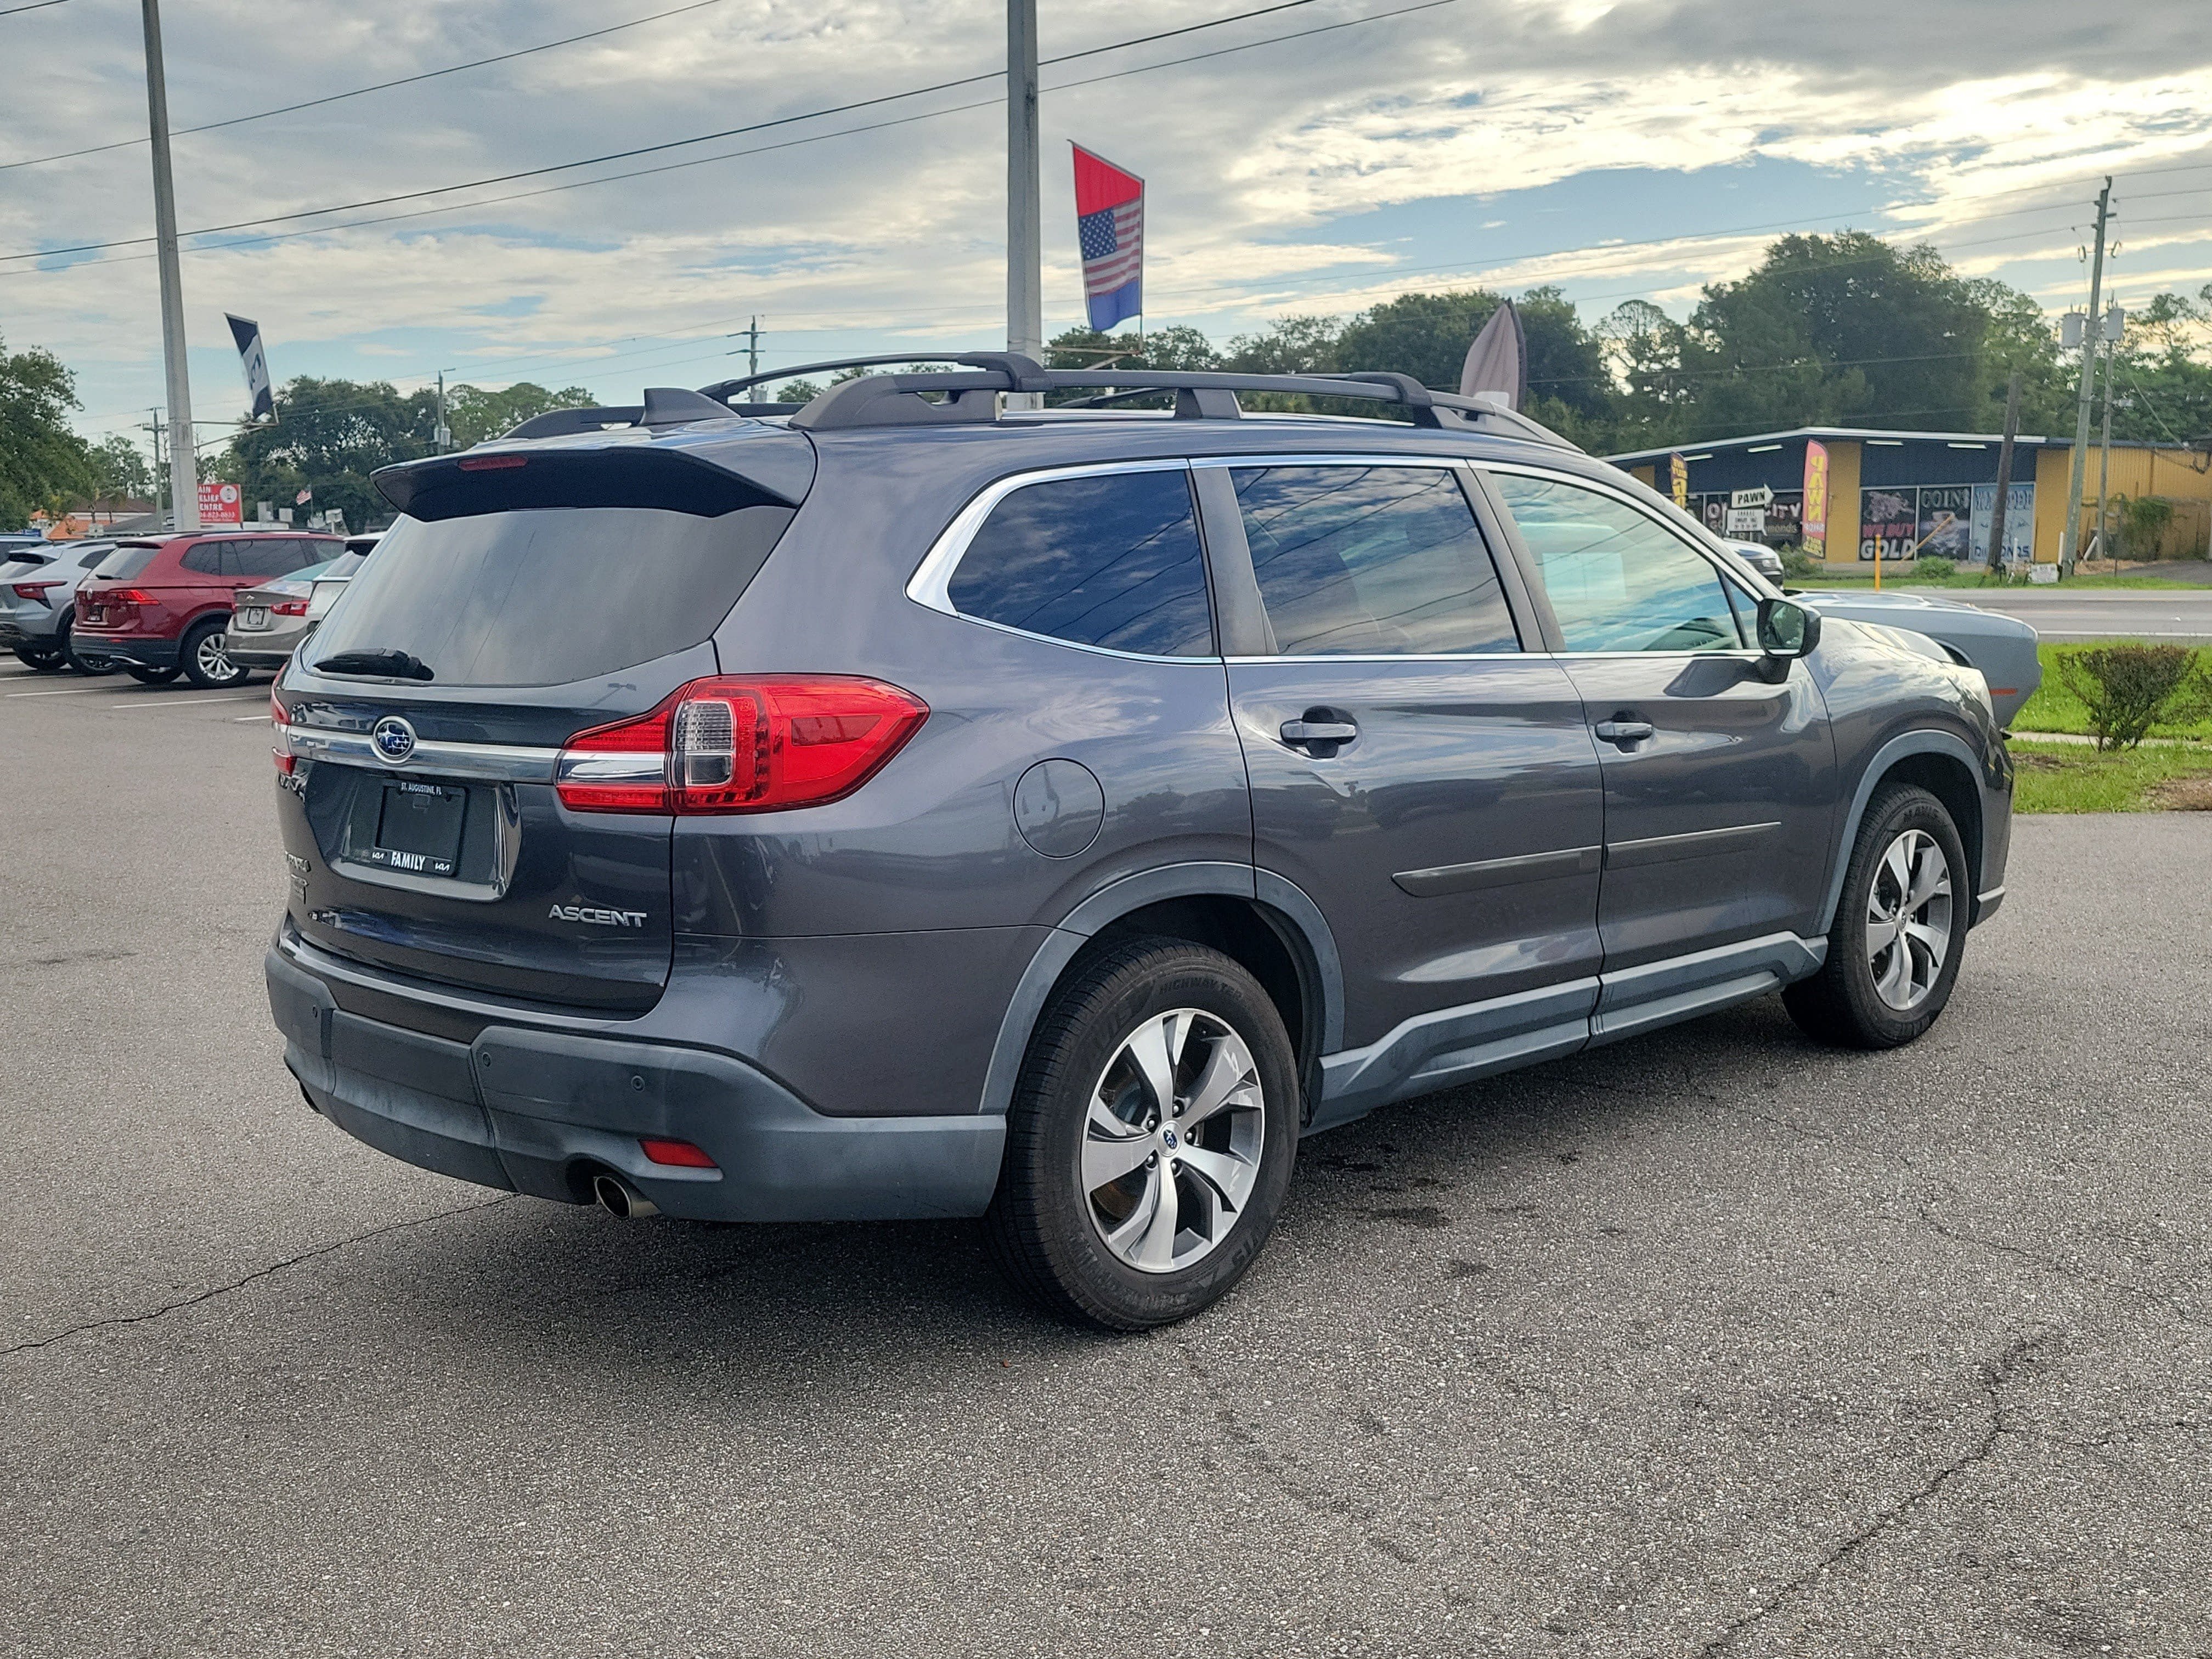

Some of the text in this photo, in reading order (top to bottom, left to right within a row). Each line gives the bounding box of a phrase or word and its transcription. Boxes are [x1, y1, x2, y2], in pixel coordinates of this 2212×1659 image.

[1737, 490, 1765, 504] PAWN
[1860, 539, 1915, 560] GOLD
[408, 783, 435, 795] AUGUSTINE,
[436, 787, 442, 795] FL
[391, 851, 426, 871] FAMILY
[549, 905, 647, 927] ASCENT
